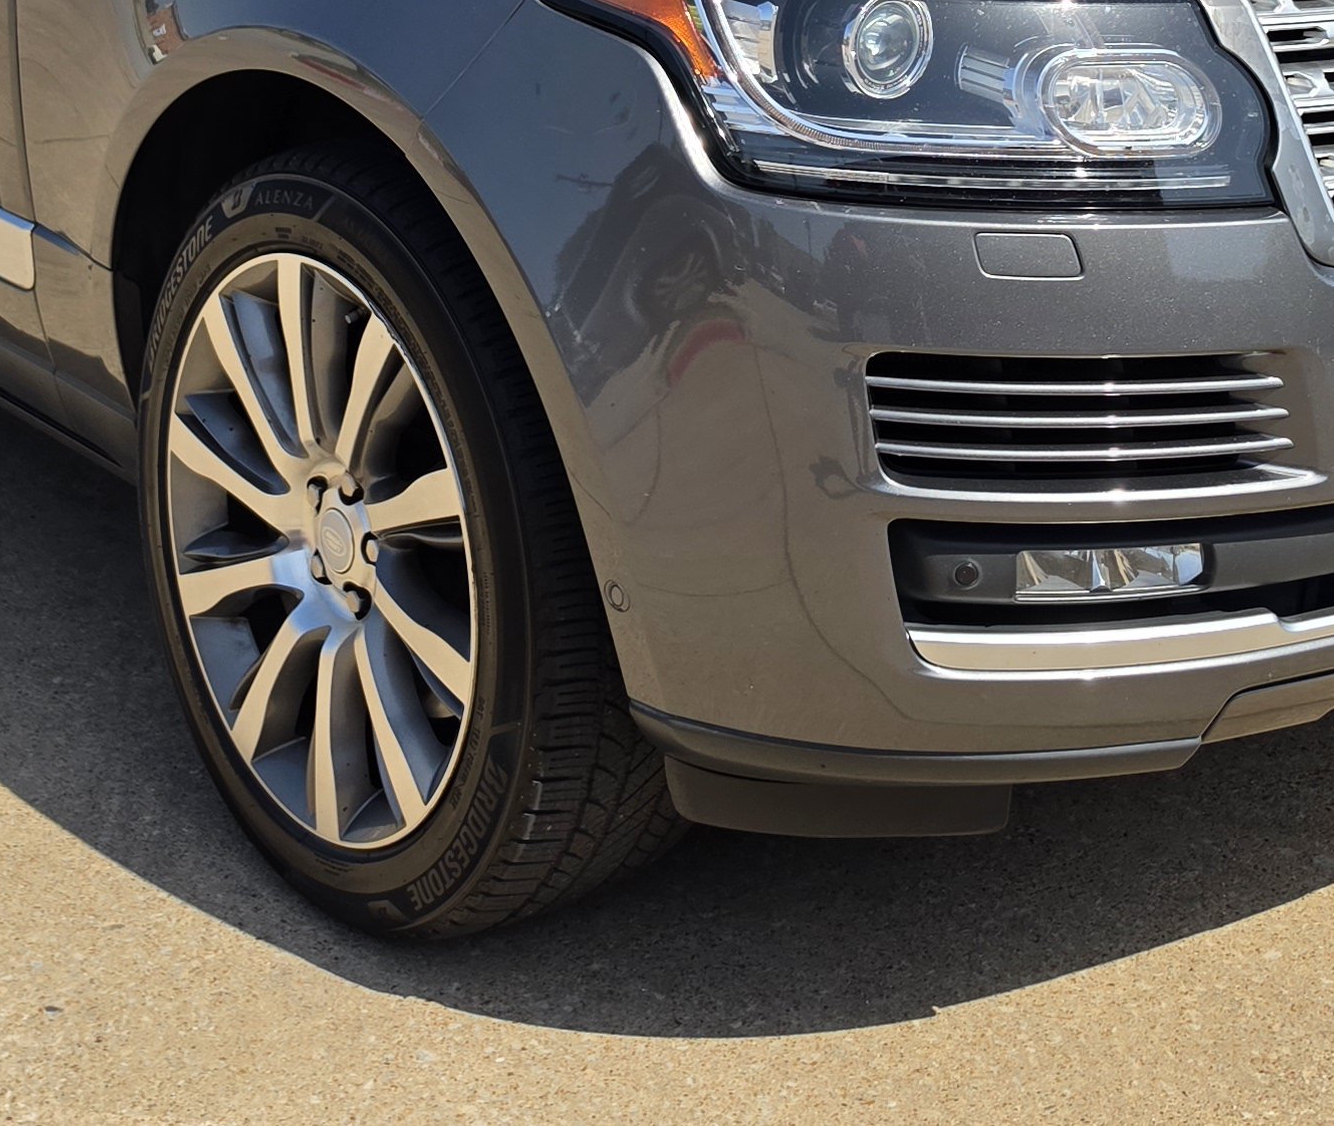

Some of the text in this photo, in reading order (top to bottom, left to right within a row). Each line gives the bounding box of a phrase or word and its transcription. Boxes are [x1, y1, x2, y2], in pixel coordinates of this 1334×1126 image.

[146, 215, 214, 373] BRIDGESTONE
[255, 189, 314, 210] ALENZA
[407, 755, 509, 911] BRIDGESTONE
